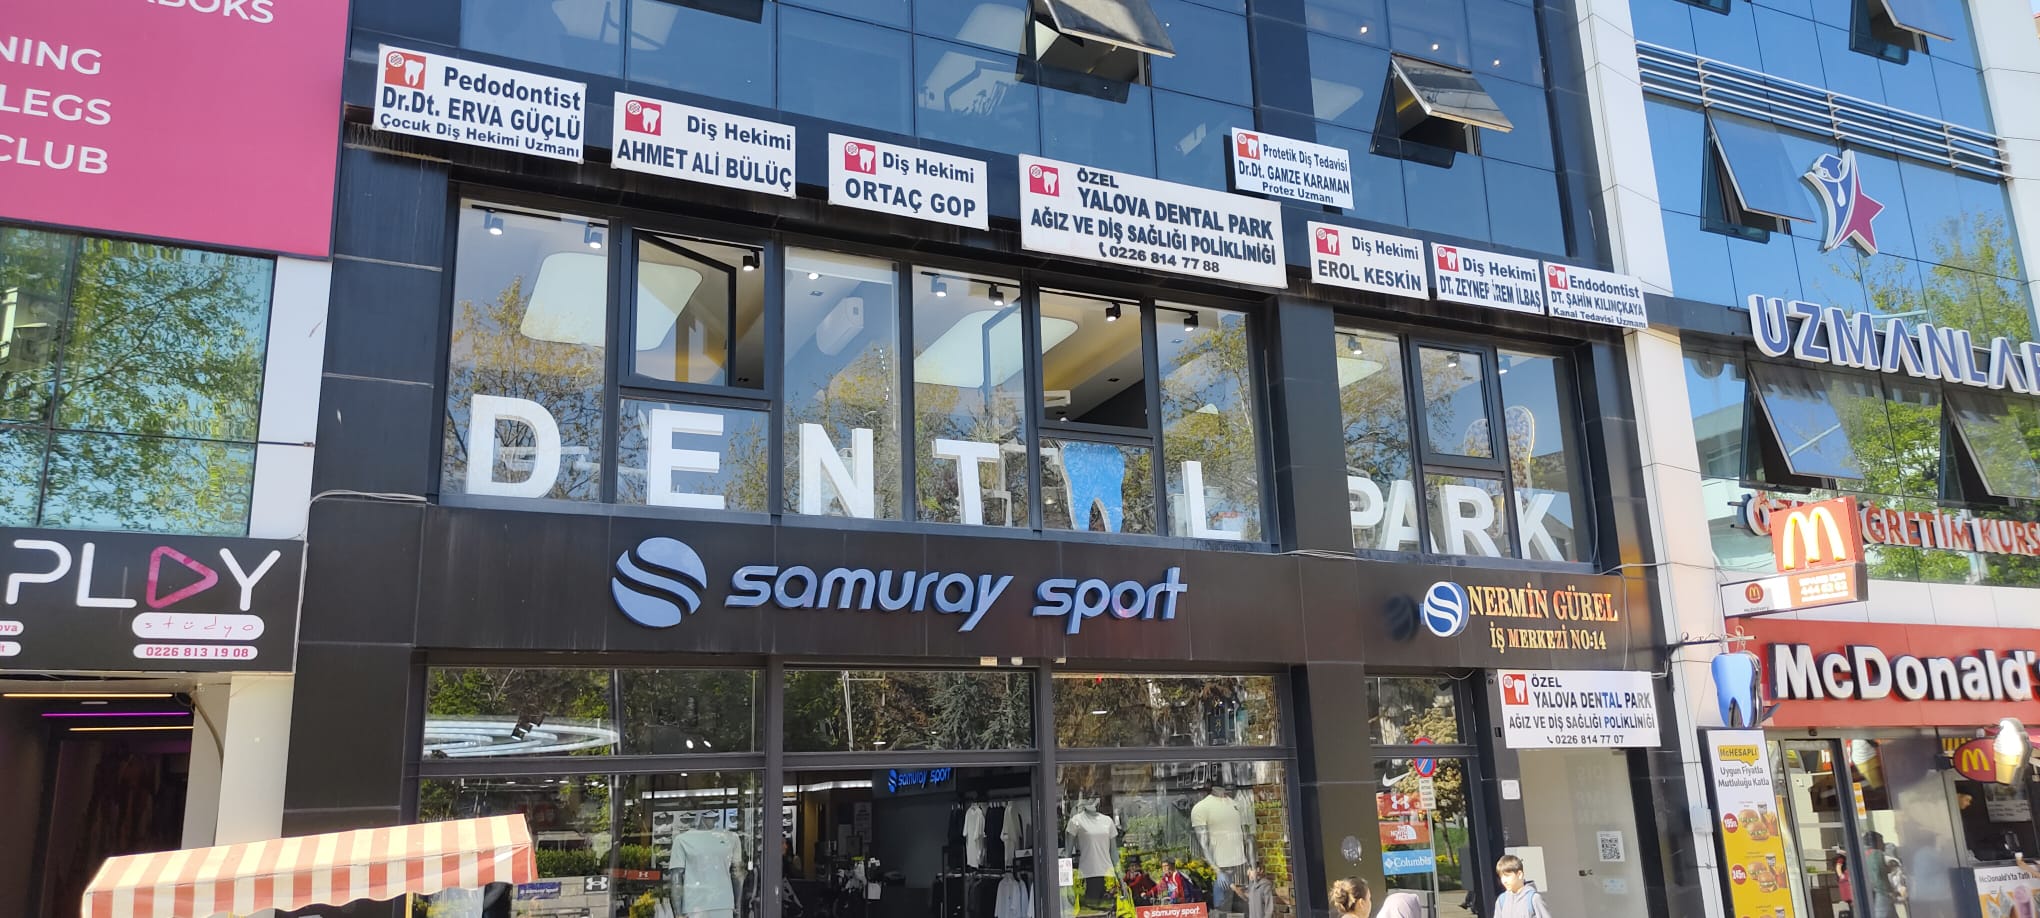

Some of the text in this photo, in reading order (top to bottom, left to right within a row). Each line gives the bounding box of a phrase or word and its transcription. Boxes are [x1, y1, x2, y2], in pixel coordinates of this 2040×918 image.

[444, 66, 581, 111] Pedodontist
[0, 84, 111, 125] LEGS
[382, 87, 580, 140] Dr.Dt. ERVA GÜÇLÜ
[380, 114, 579, 158] Çocuk Diş Hekimi Uzmanı
[687, 115, 791, 151] Diş Hekimi
[617, 139, 792, 192] AHMET ALİ BÜLÜÇ
[882, 152, 974, 183] Diş Hekimi
[1263, 144, 1348, 172] Protetik Diş Tedavisi
[1077, 168, 1119, 188] ÖZEL
[1239, 160, 1350, 194] Dr.Dt. GAMZE KARAMAN
[845, 178, 976, 218] ORTAÇ GOP
[1262, 182, 1334, 204] Protez Uzmanı
[1078, 188, 1274, 240] YALOVA DENTAL PARK
[1031, 207, 1276, 266] AĞIZ VE DİŞ SAĞLIĞI POLİKLİNİĞİ
[1352, 236, 1419, 260] Diş Hekimi
[1110, 246, 1220, 273] 0226 814 77 88
[1463, 257, 1537, 283] Diş Hekimi
[1318, 260, 1421, 292] EROL KESKİN
[1570, 275, 1640, 299] Endodontist
[1440, 276, 1454, 294] DT.
[1516, 283, 1541, 313] İLBAŞ
[1552, 291, 1644, 317] DT. ŞAHİN KILINÇKAYA
[1553, 308, 1646, 329] Kanal Tedavisi Uzmanı
[1348, 476, 1565, 562] PARK
[725, 565, 1188, 635] samuray sport
[1467, 582, 1618, 622] NERMİN GÜREL
[145, 616, 254, 638] stüdyo
[1490, 622, 1505, 653] İŞ
[1508, 624, 1567, 650] MERKEZİ
[146, 647, 249, 658] 0226 813 19 08
[1532, 674, 1562, 688] ÖZEL
[1534, 692, 1652, 709] YALOVA DENTAL PARK
[1510, 713, 1655, 732] AĞIZ VE DİŞ SAĞLIĞI POLİKLİNİĞİ
[1555, 735, 1624, 744] 0226 814 77 07
[898, 771, 927, 789] samuray
